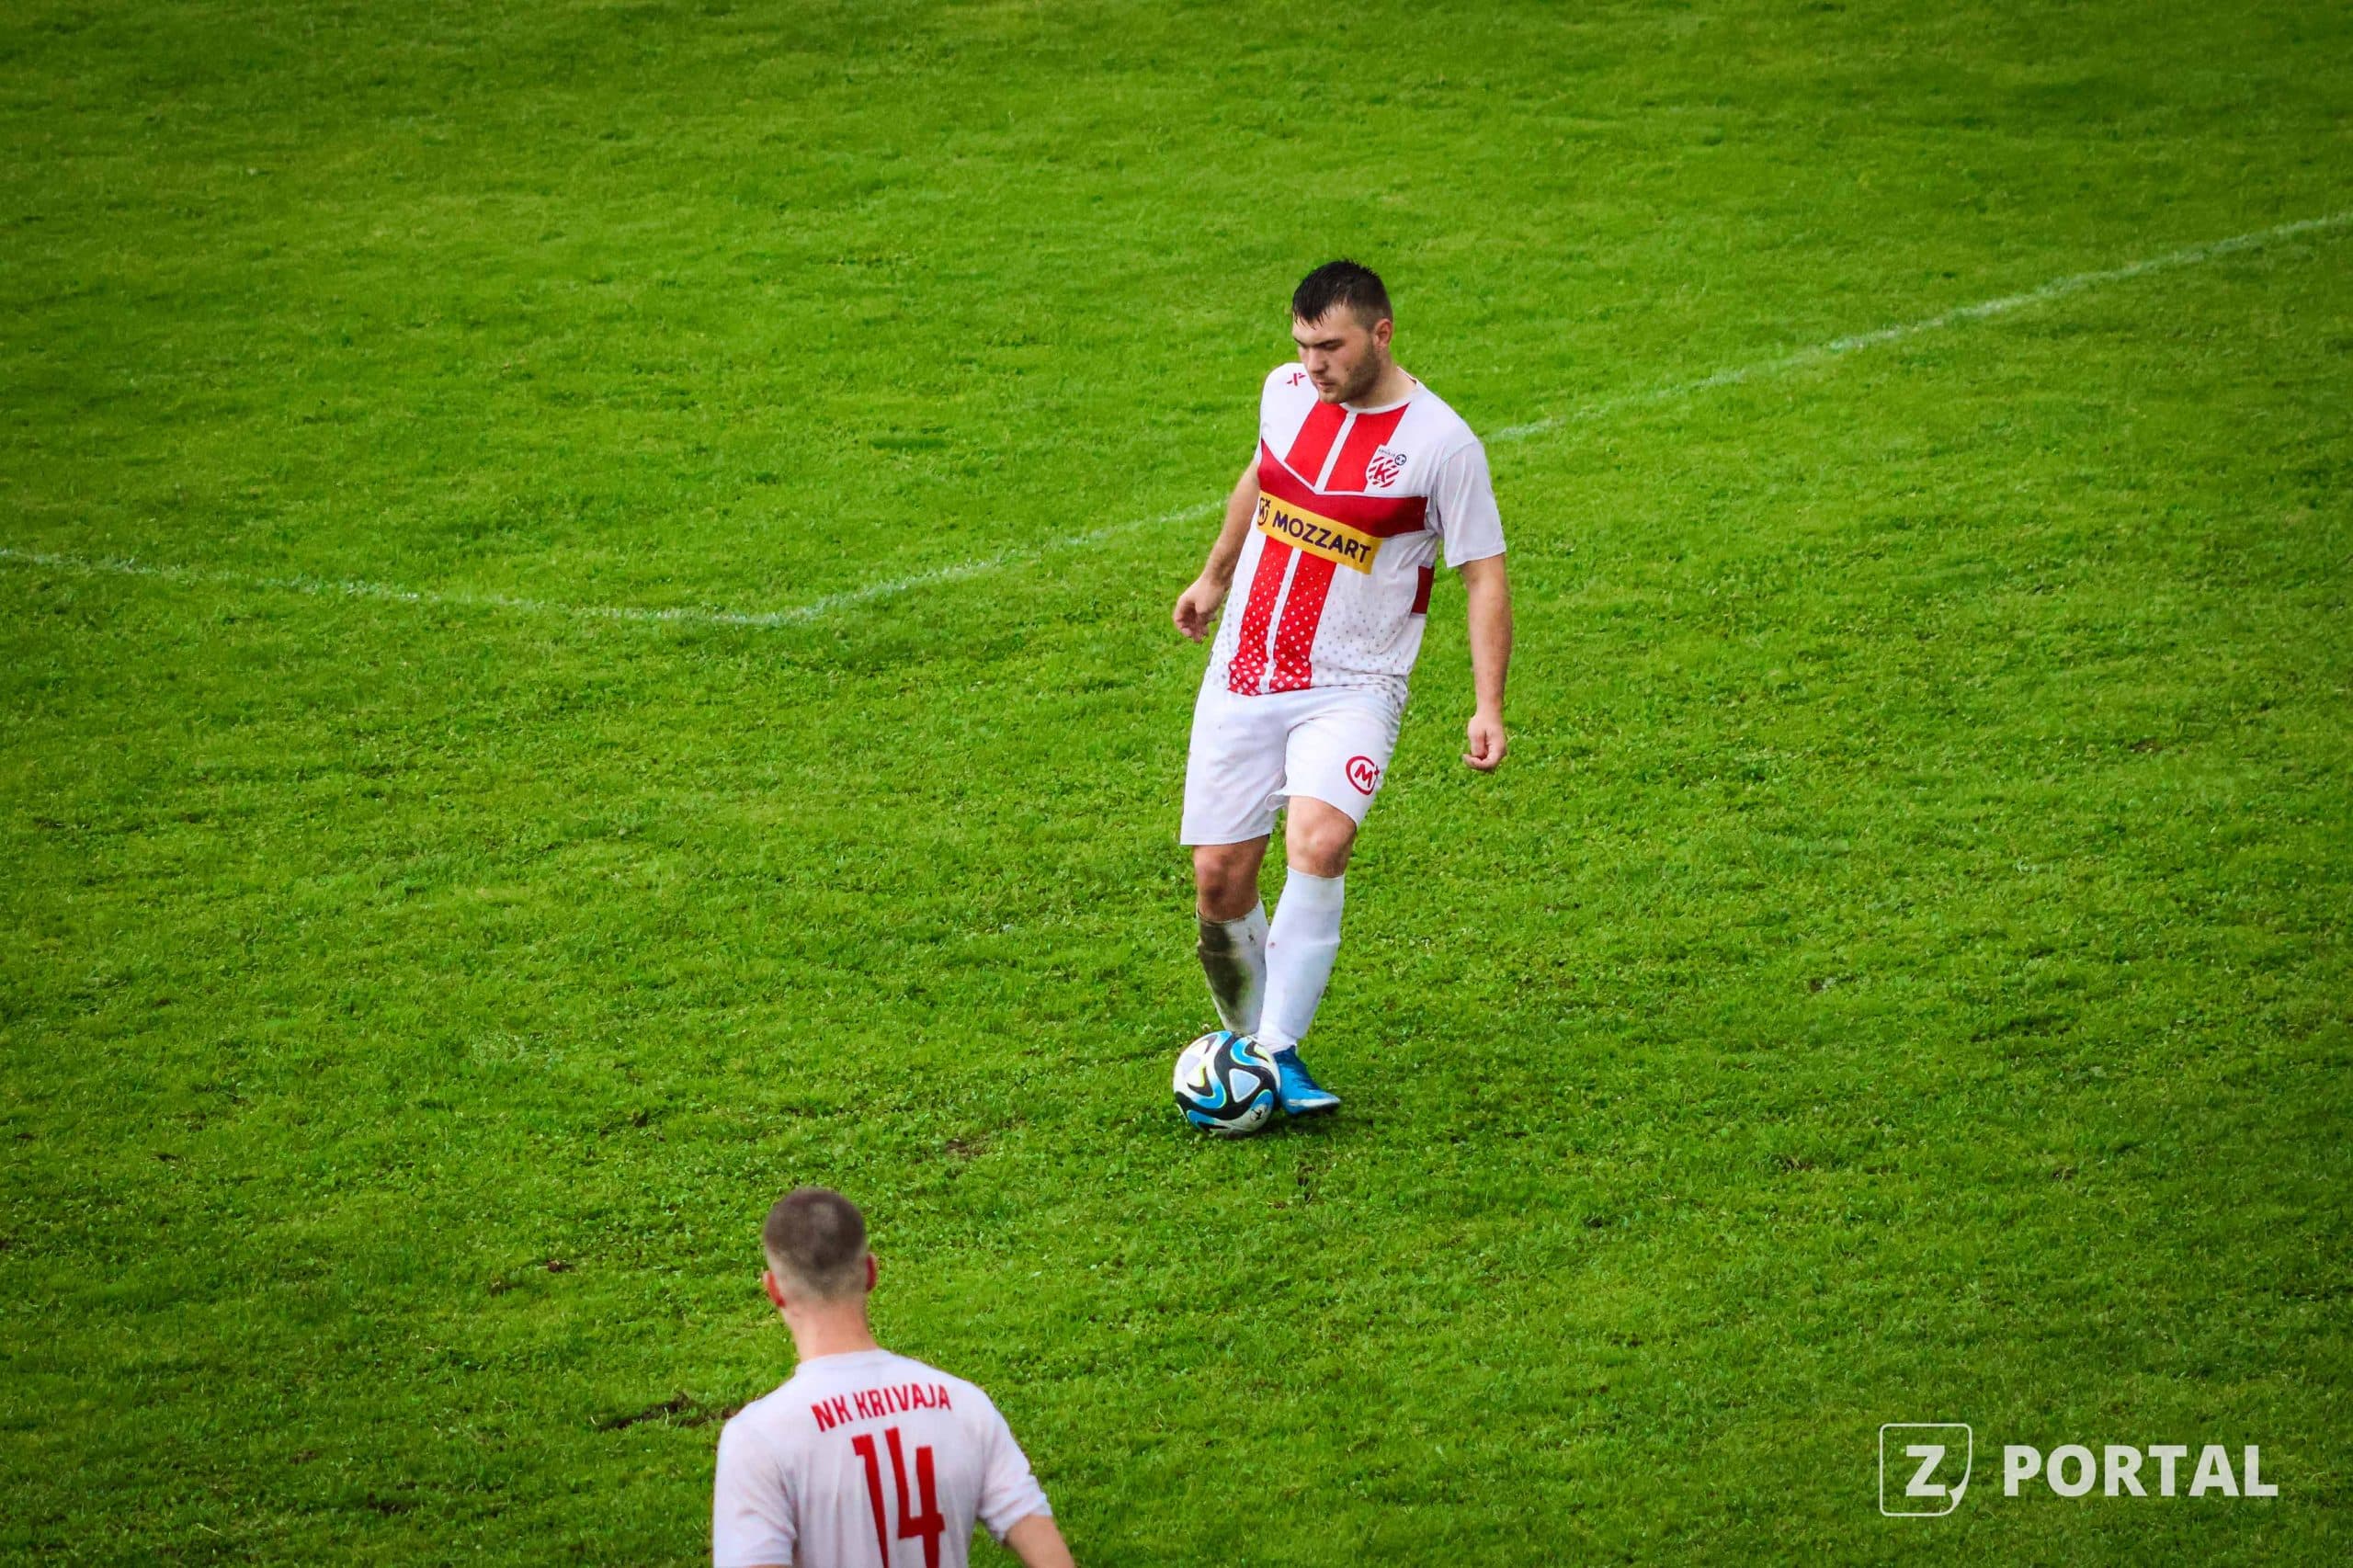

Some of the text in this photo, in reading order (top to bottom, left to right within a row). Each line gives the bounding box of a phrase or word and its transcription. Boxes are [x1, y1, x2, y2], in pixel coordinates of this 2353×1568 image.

[1272, 510, 1371, 562] MOZZART
[811, 1383, 952, 1432] NK KRIVAJA
[851, 1426, 946, 1568] 14
